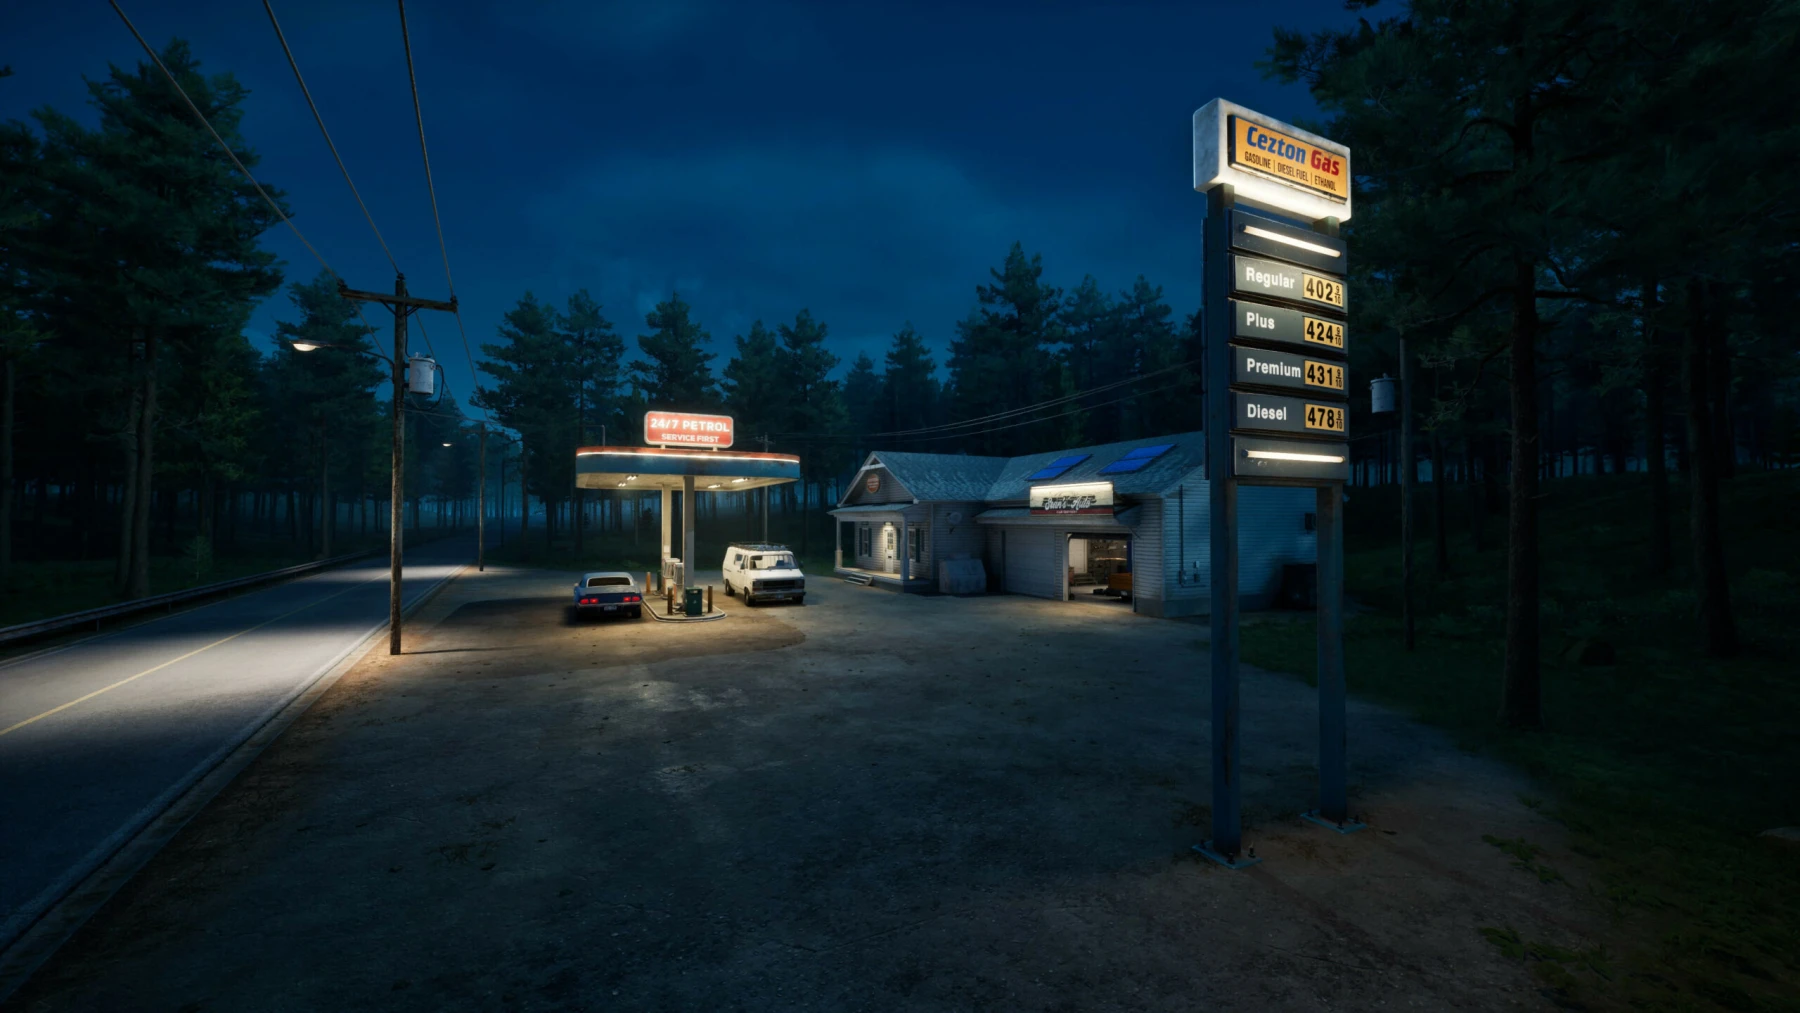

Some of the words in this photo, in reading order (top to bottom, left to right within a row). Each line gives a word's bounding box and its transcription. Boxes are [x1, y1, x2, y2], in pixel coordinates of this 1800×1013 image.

[1246, 126, 1306, 164] Cezton
[1310, 149, 1340, 176] Gas
[1244, 151, 1271, 169] GASOLINE
[1277, 162, 1295, 178] DIESEL
[1296, 168, 1309, 182] FUEL
[1314, 175, 1337, 191] ETHANOL
[1246, 267, 1295, 289] Regular
[1246, 312, 1275, 329] Plus
[1246, 358, 1302, 378] Premium
[1247, 403, 1287, 421] Diesel
[650, 418, 680, 429] 24/7
[682, 420, 730, 432] PETROL
[661, 433, 696, 442] SERVICE
[697, 435, 720, 443] FIRST
[1070, 496, 1091, 510] Auto
